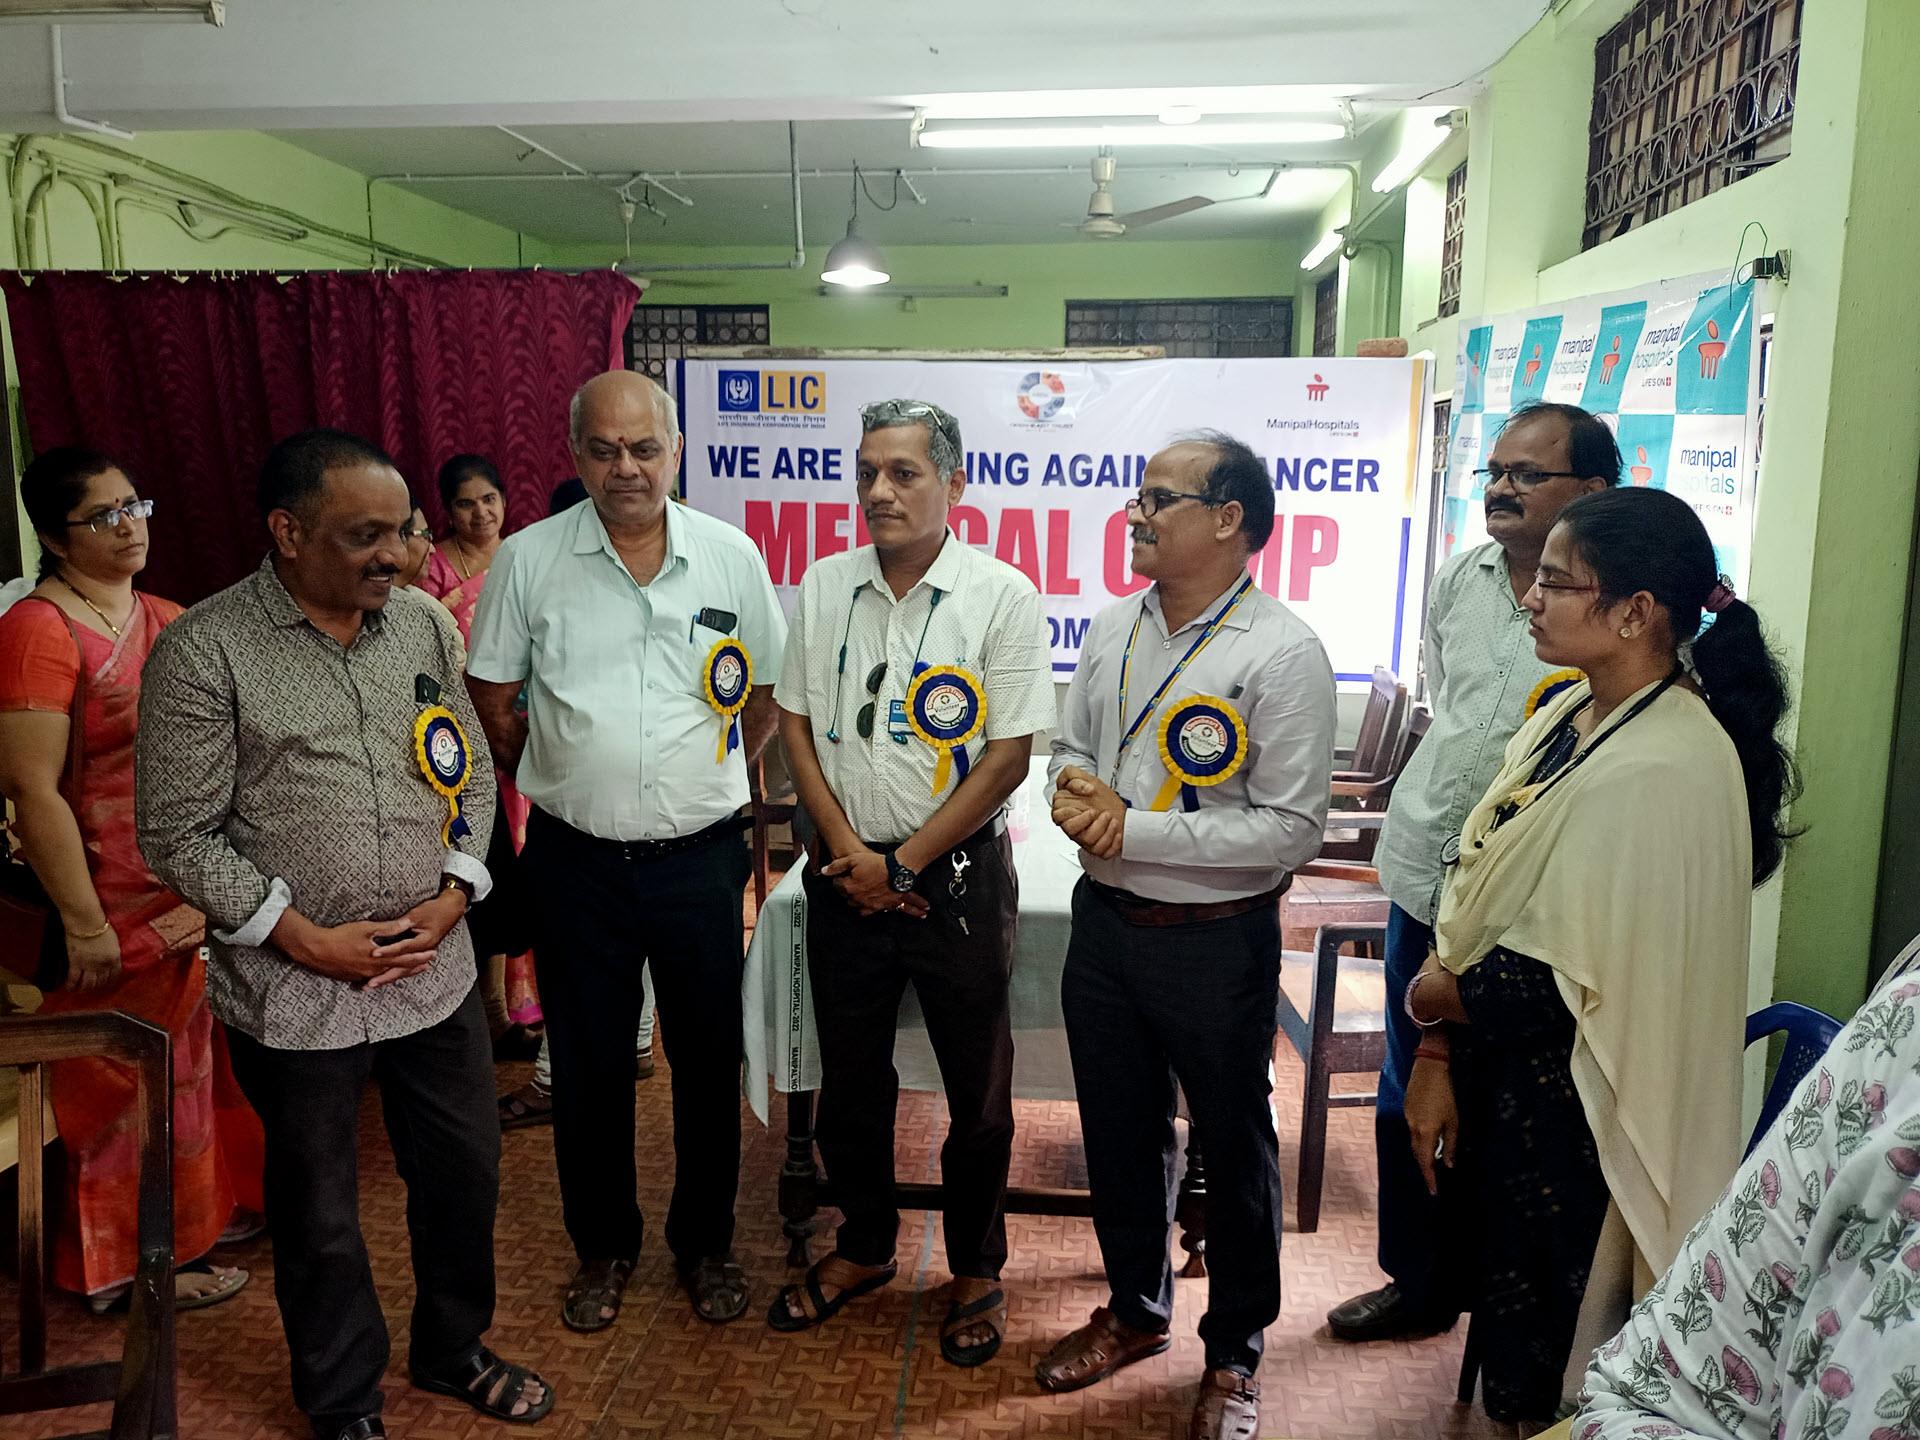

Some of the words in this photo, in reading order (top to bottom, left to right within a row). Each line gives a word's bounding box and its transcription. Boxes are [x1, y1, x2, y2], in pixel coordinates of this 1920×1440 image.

[1561, 334, 1597, 357] manipal
[1644, 320, 1686, 347] manipal
[768, 376, 819, 409] LIC
[707, 445, 760, 478] WE
[772, 447, 842, 481] ARE
[1257, 457, 1380, 492] NCER
[1680, 444, 1737, 473] manipal
[793, 943, 801, 976] MANIPAL
